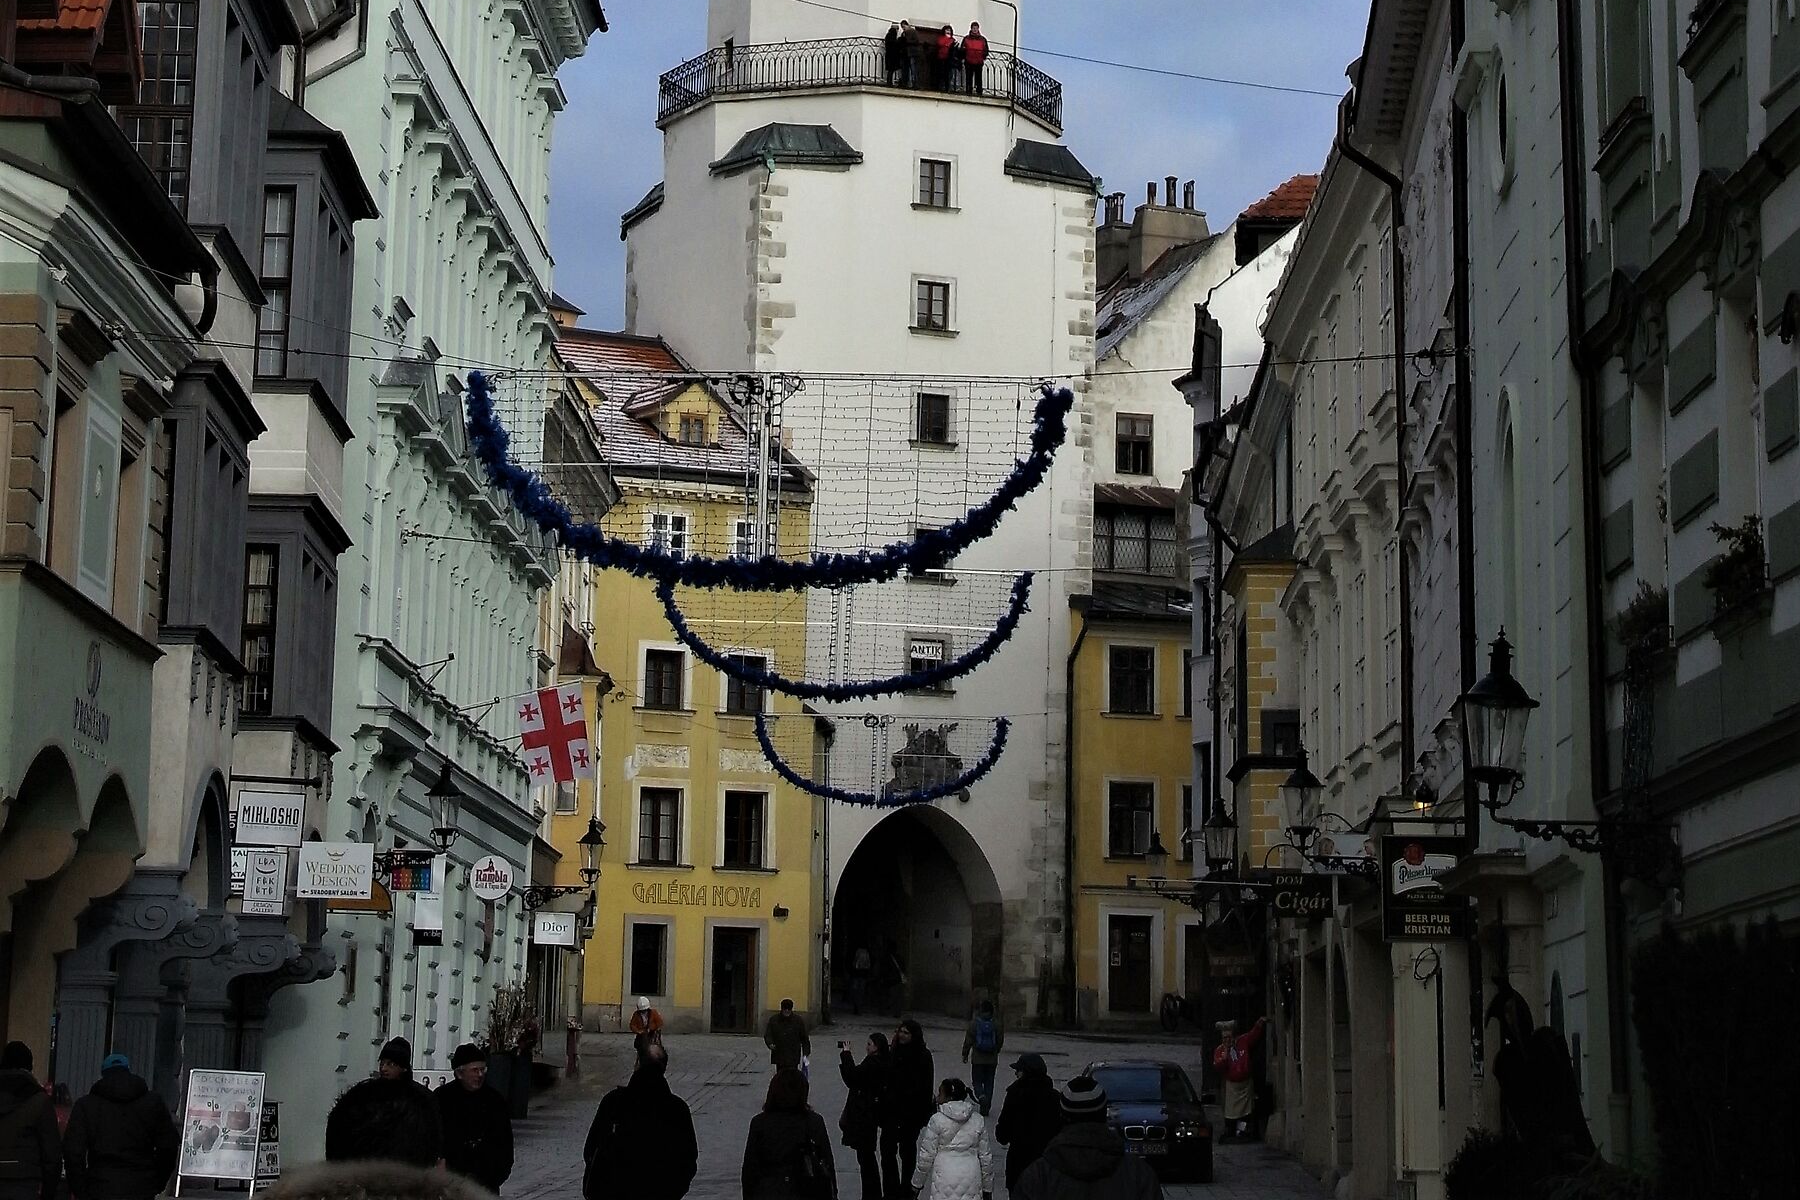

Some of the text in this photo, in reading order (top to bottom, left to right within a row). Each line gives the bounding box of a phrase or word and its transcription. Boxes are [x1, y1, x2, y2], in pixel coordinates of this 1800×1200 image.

[911, 645, 941, 654] ANTIK
[306, 861, 366, 875] WEDDING
[311, 874, 358, 887] DESIGN
[476, 869, 508, 883] Rambla
[1275, 875, 1303, 885] DOM
[1399, 866, 1426, 884] Pilsner
[632, 879, 761, 908] GALÉRIA NOVA
[1274, 890, 1331, 914] Cigár
[1405, 913, 1450, 923] BEER PUB
[542, 921, 568, 932] Dior
[1404, 925, 1451, 934] KRISTIAN
